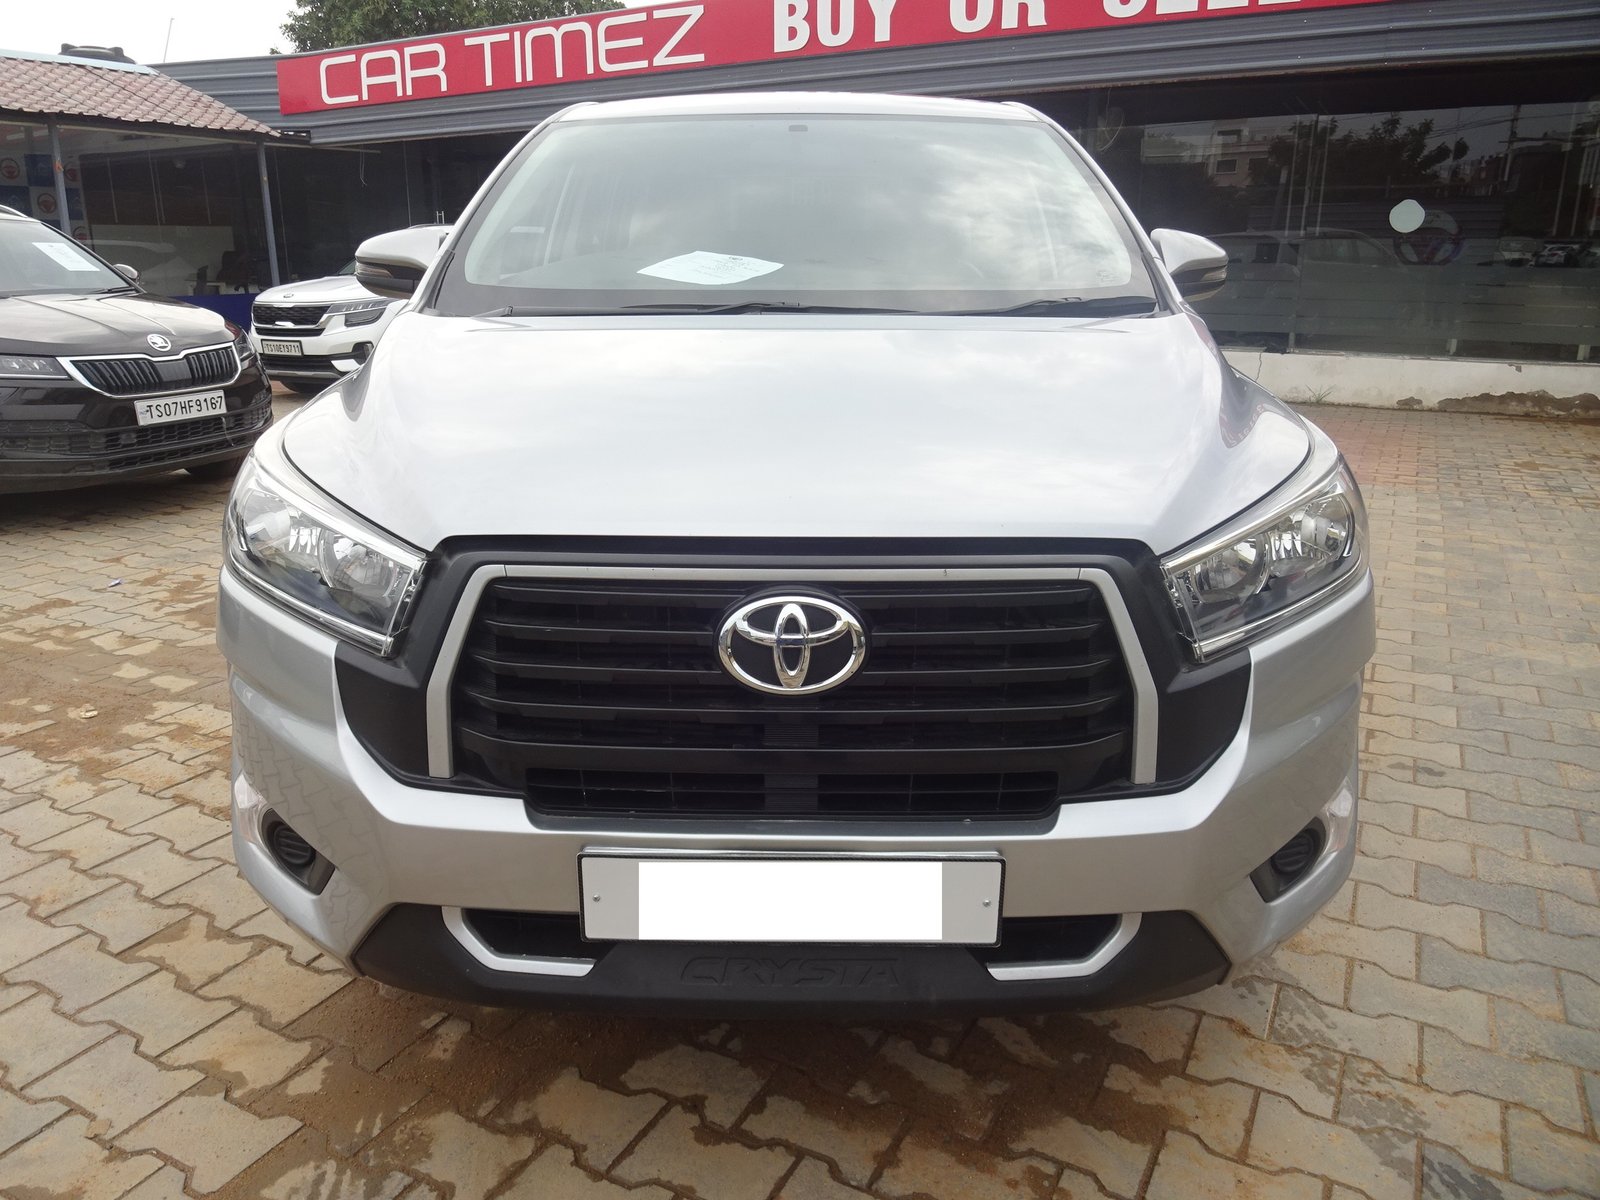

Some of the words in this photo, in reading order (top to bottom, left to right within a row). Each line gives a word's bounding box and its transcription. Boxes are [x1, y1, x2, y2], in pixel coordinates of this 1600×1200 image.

[319, 43, 448, 105] CAR
[464, 4, 705, 87] TIMEZ
[773, 0, 897, 53] BUY
[146, 395, 223, 419] TS07HF9167
[680, 956, 900, 987] CRYSTA
